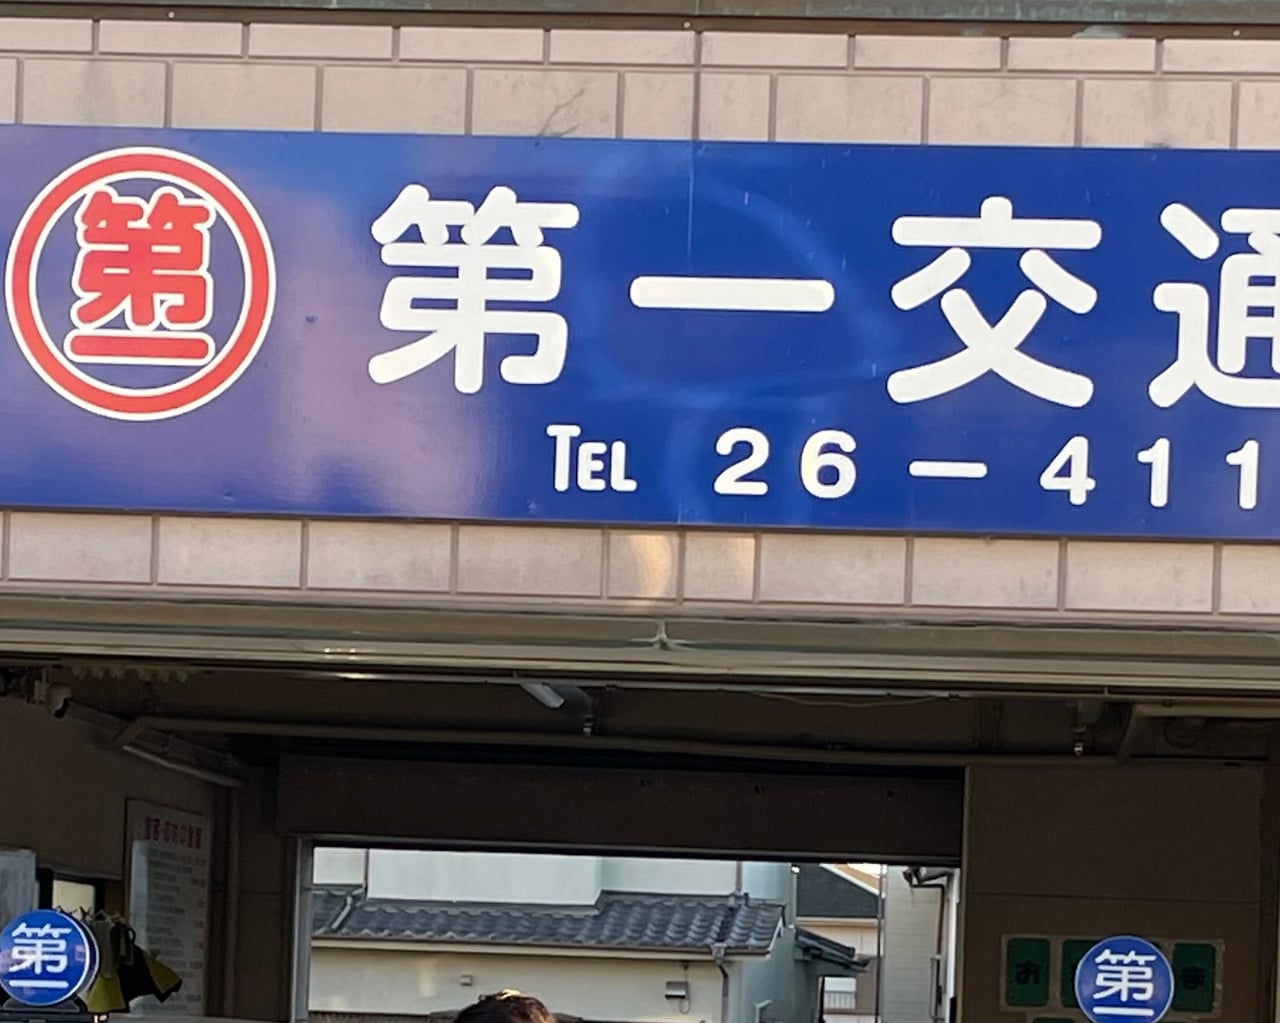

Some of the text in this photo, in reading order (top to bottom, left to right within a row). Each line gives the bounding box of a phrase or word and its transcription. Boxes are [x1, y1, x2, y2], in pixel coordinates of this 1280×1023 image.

[63, 183, 218, 366] 第一
[9, 921, 72, 988] 第一
[1092, 948, 1158, 1017] 第一
